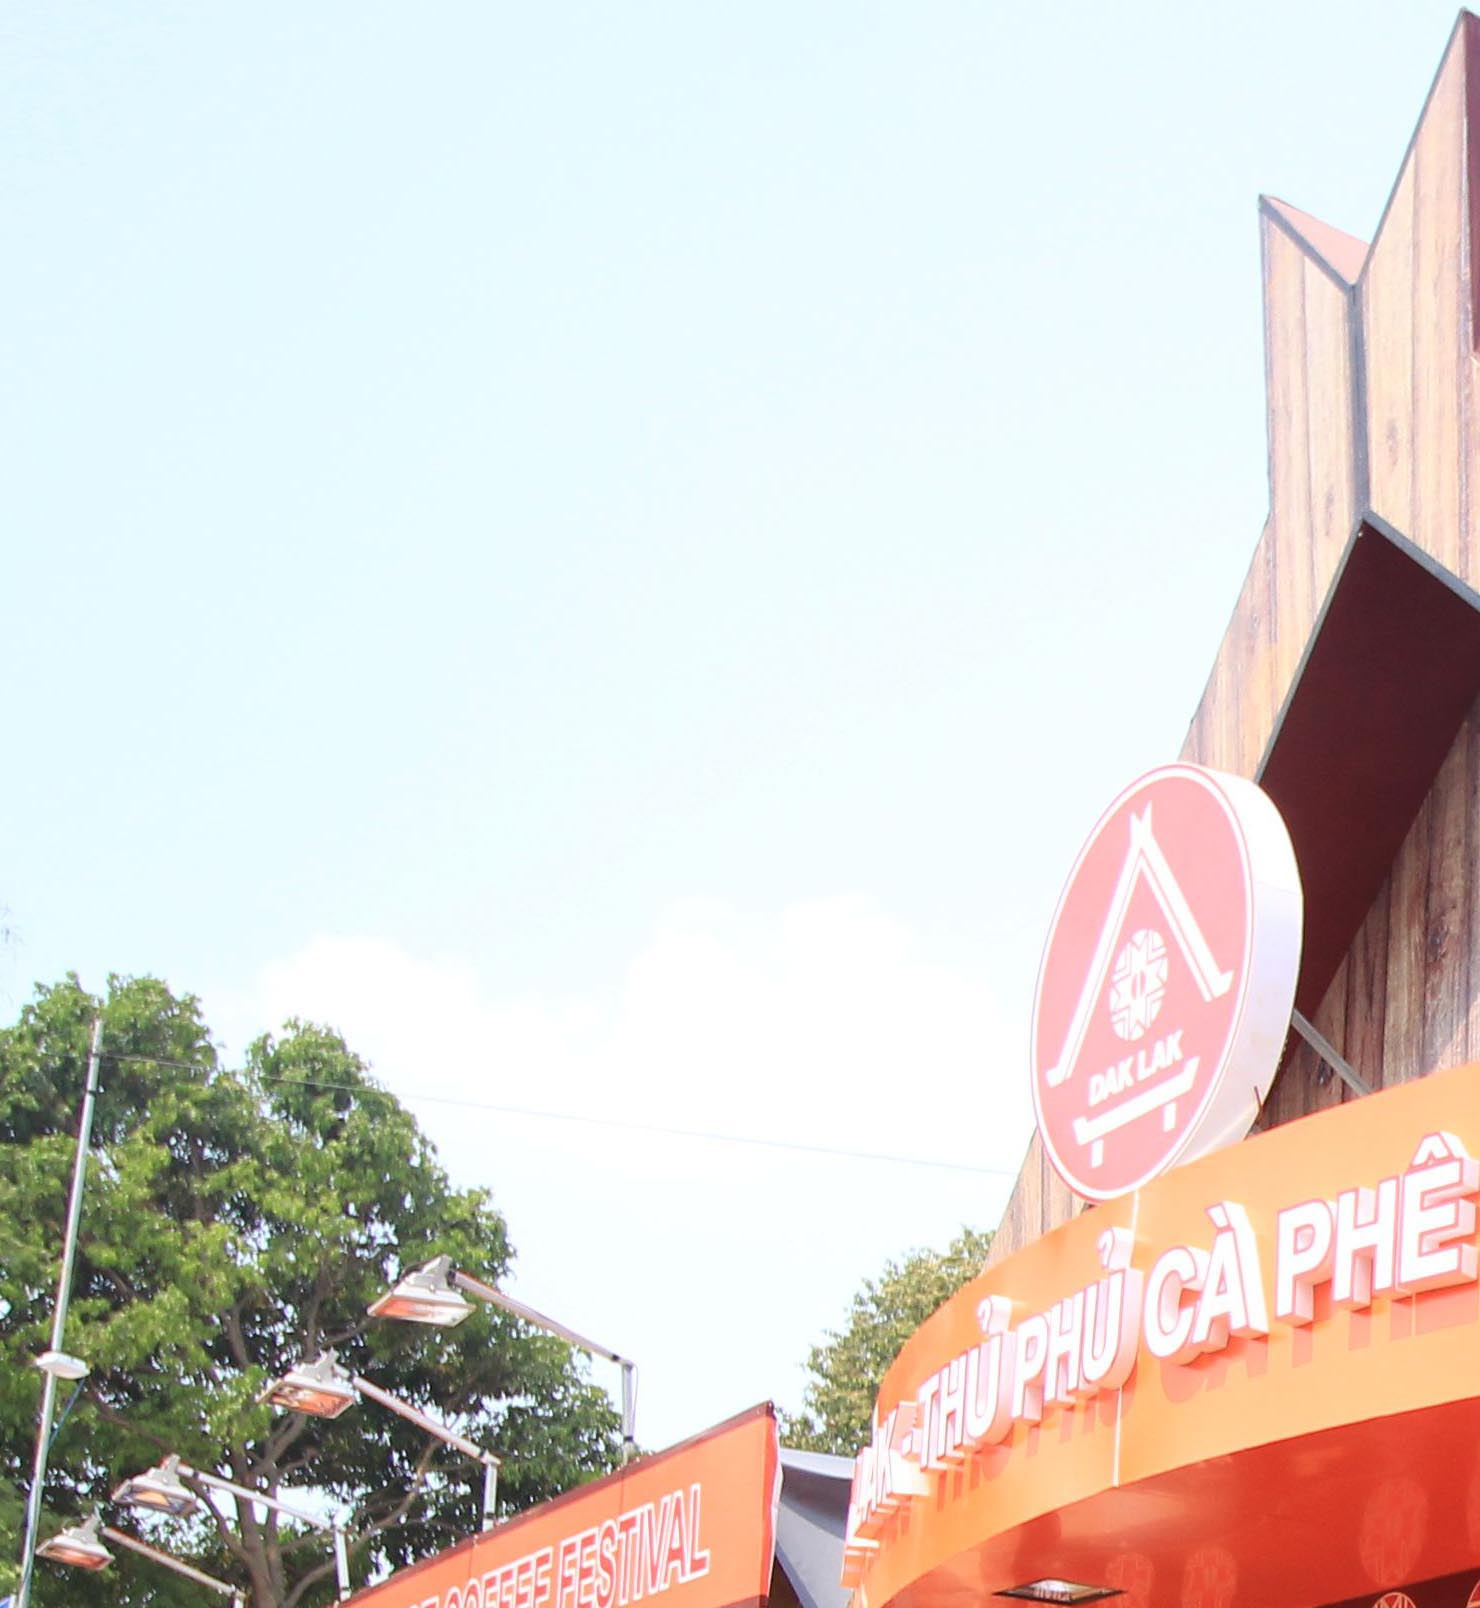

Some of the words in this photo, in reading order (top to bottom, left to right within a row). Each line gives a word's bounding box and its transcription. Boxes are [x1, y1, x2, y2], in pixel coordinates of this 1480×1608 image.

[918, 1296, 1012, 1470] THỦ
[1012, 1227, 1143, 1423] PHỦ
[1143, 1202, 1269, 1365] CÀ
[1274, 1131, 1479, 1328] PHÊ
